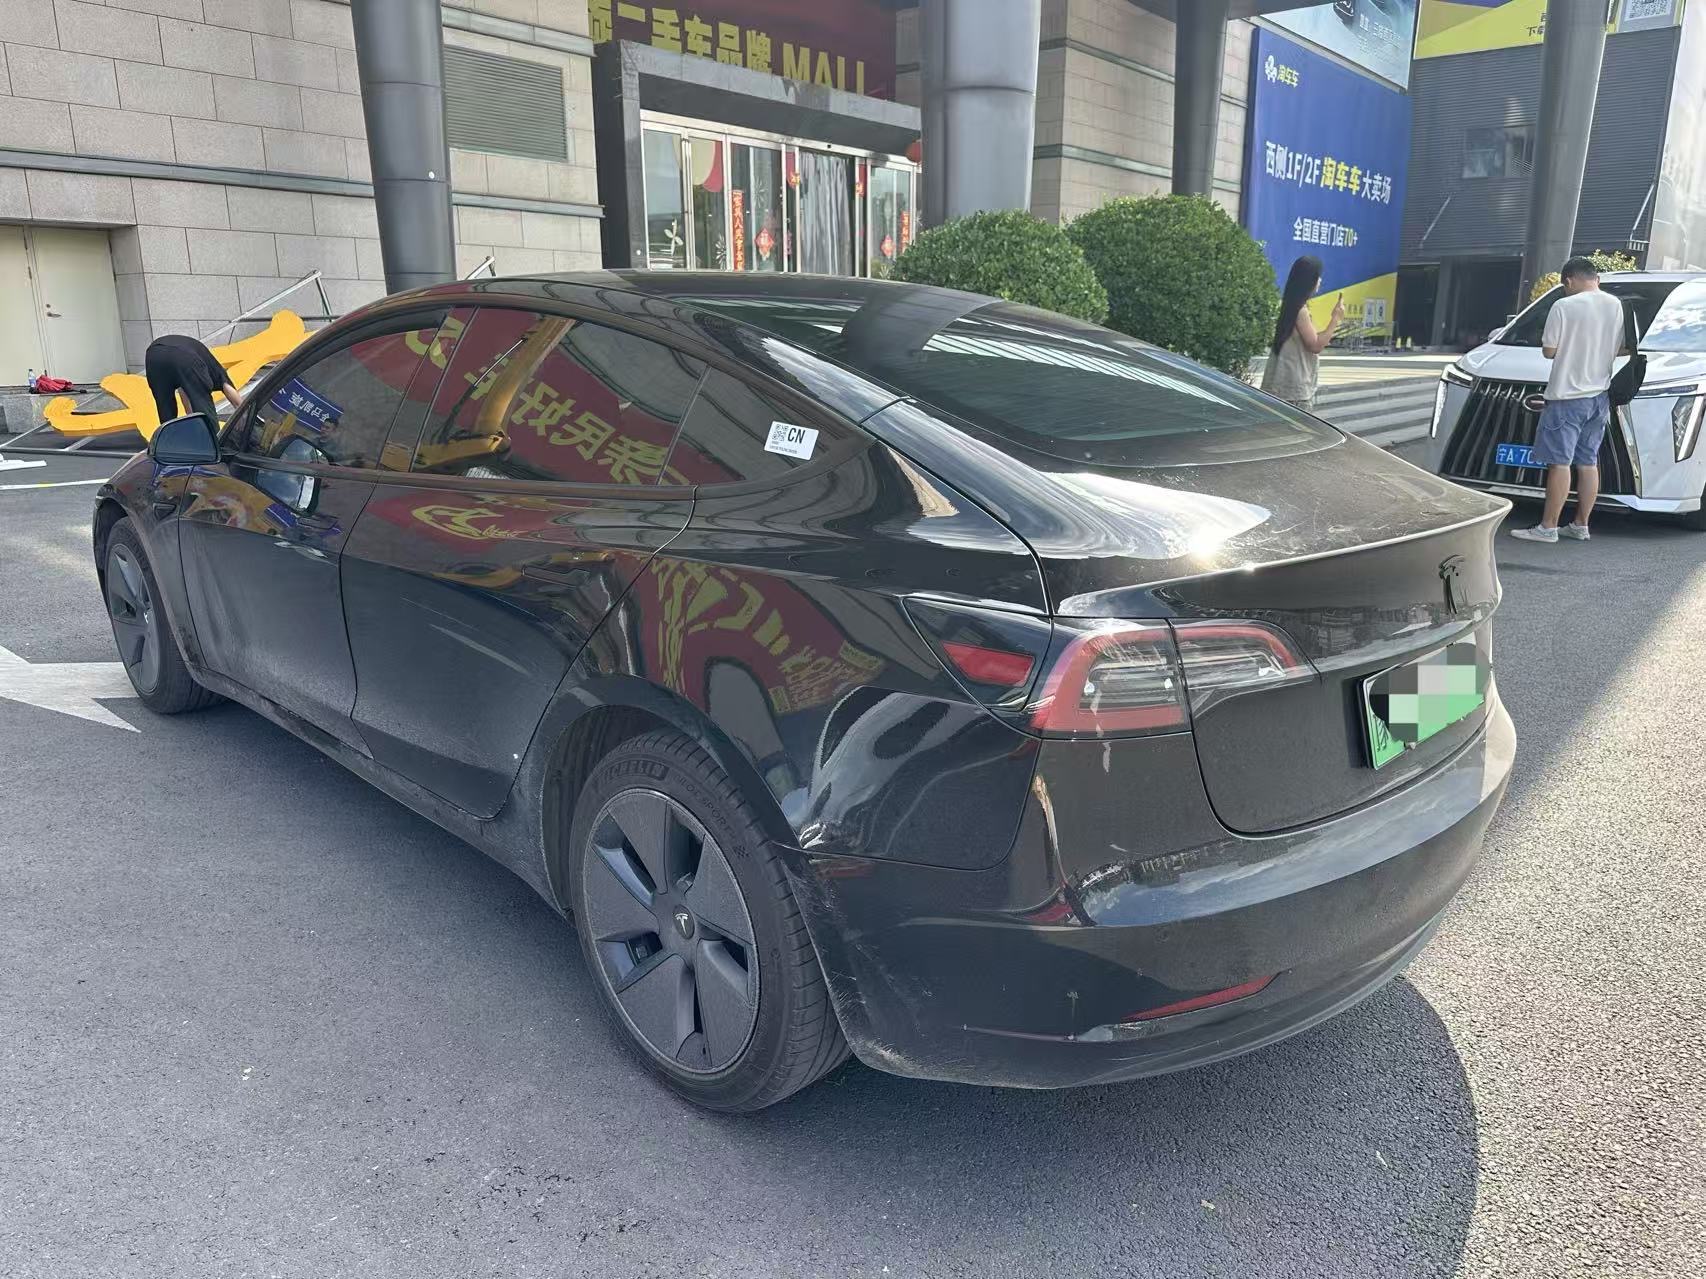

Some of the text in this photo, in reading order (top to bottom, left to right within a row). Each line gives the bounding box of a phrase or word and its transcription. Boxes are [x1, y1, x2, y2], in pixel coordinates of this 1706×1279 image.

[783, 42, 865, 95] MALL
[1277, 64, 1299, 88] 淘车车
[1293, 216, 1358, 247] 全国直营门店70+
[787, 427, 806, 444] CN
